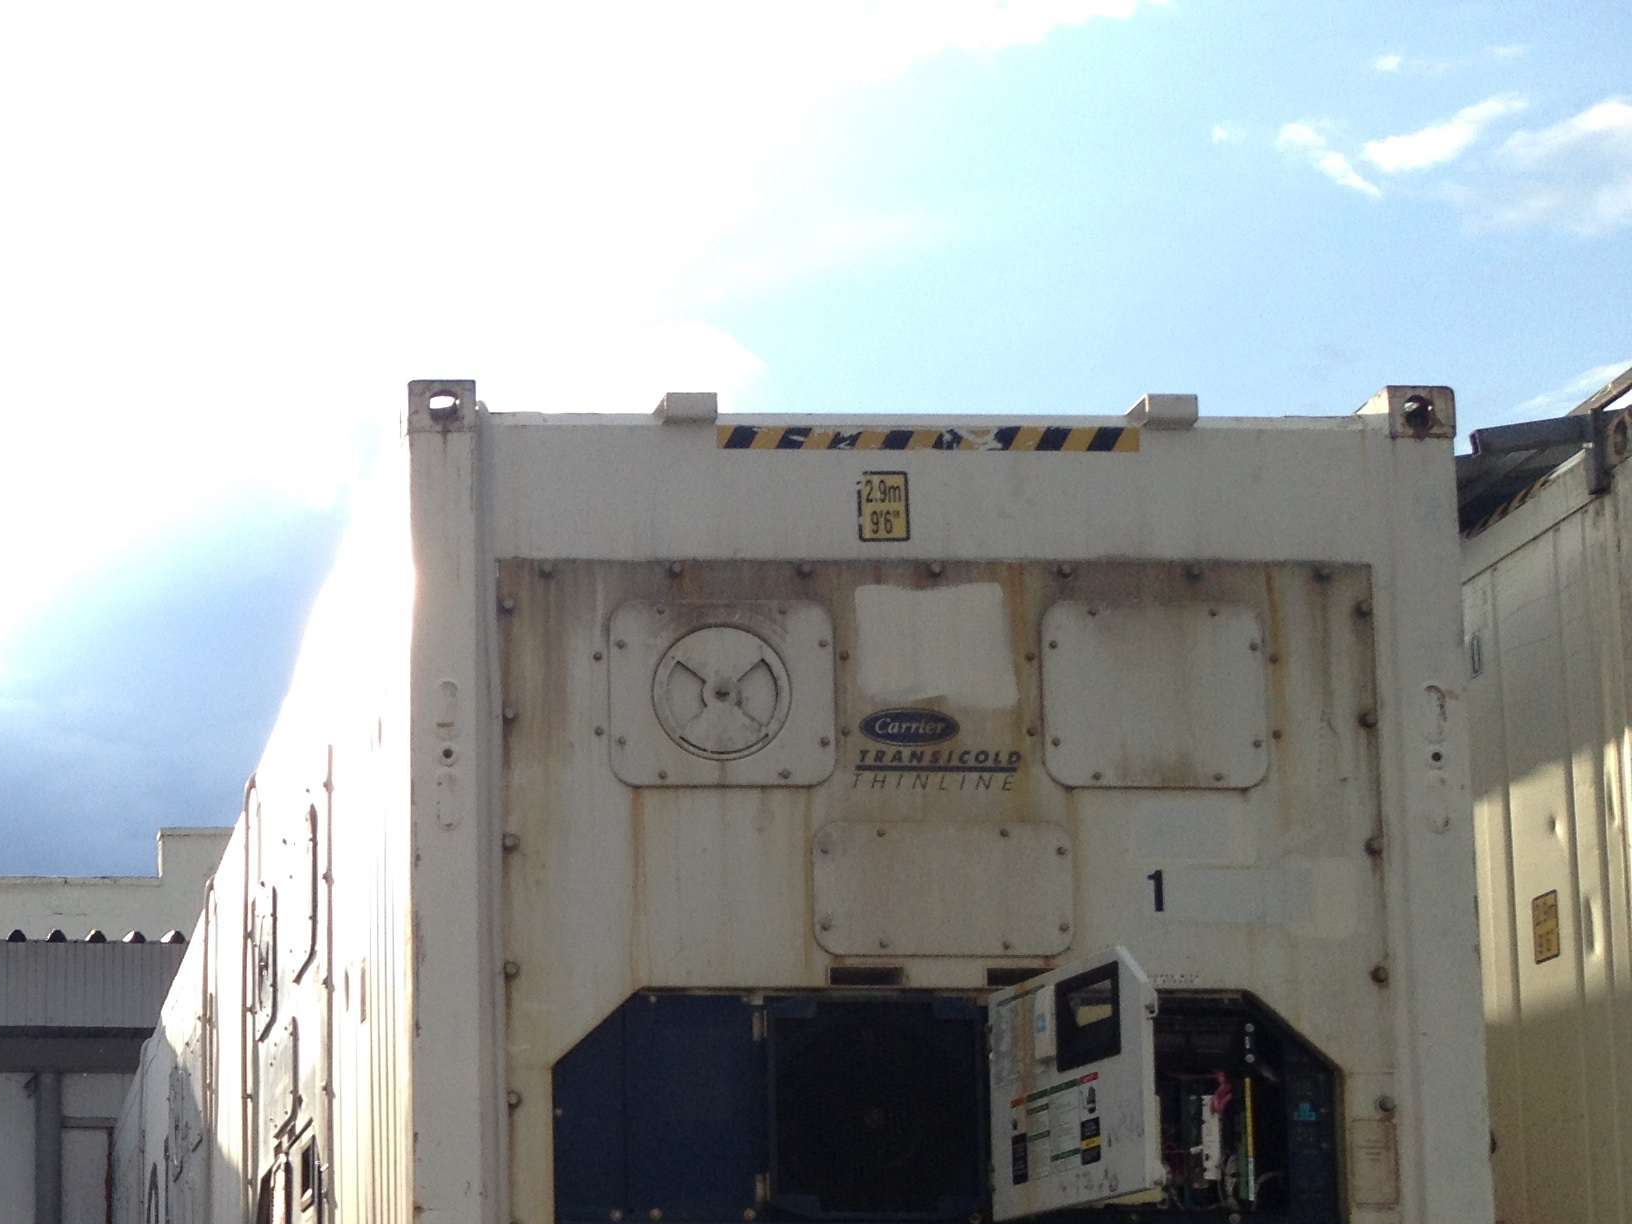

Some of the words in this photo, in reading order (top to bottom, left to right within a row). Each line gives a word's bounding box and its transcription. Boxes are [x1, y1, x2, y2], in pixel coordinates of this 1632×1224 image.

[865, 480, 902, 503] 2.9m
[874, 718, 947, 736] Carrier
[857, 749, 1023, 766] TRANSICOLD
[852, 772, 1016, 792] THINLINE
[1147, 868, 1165, 913] 1
